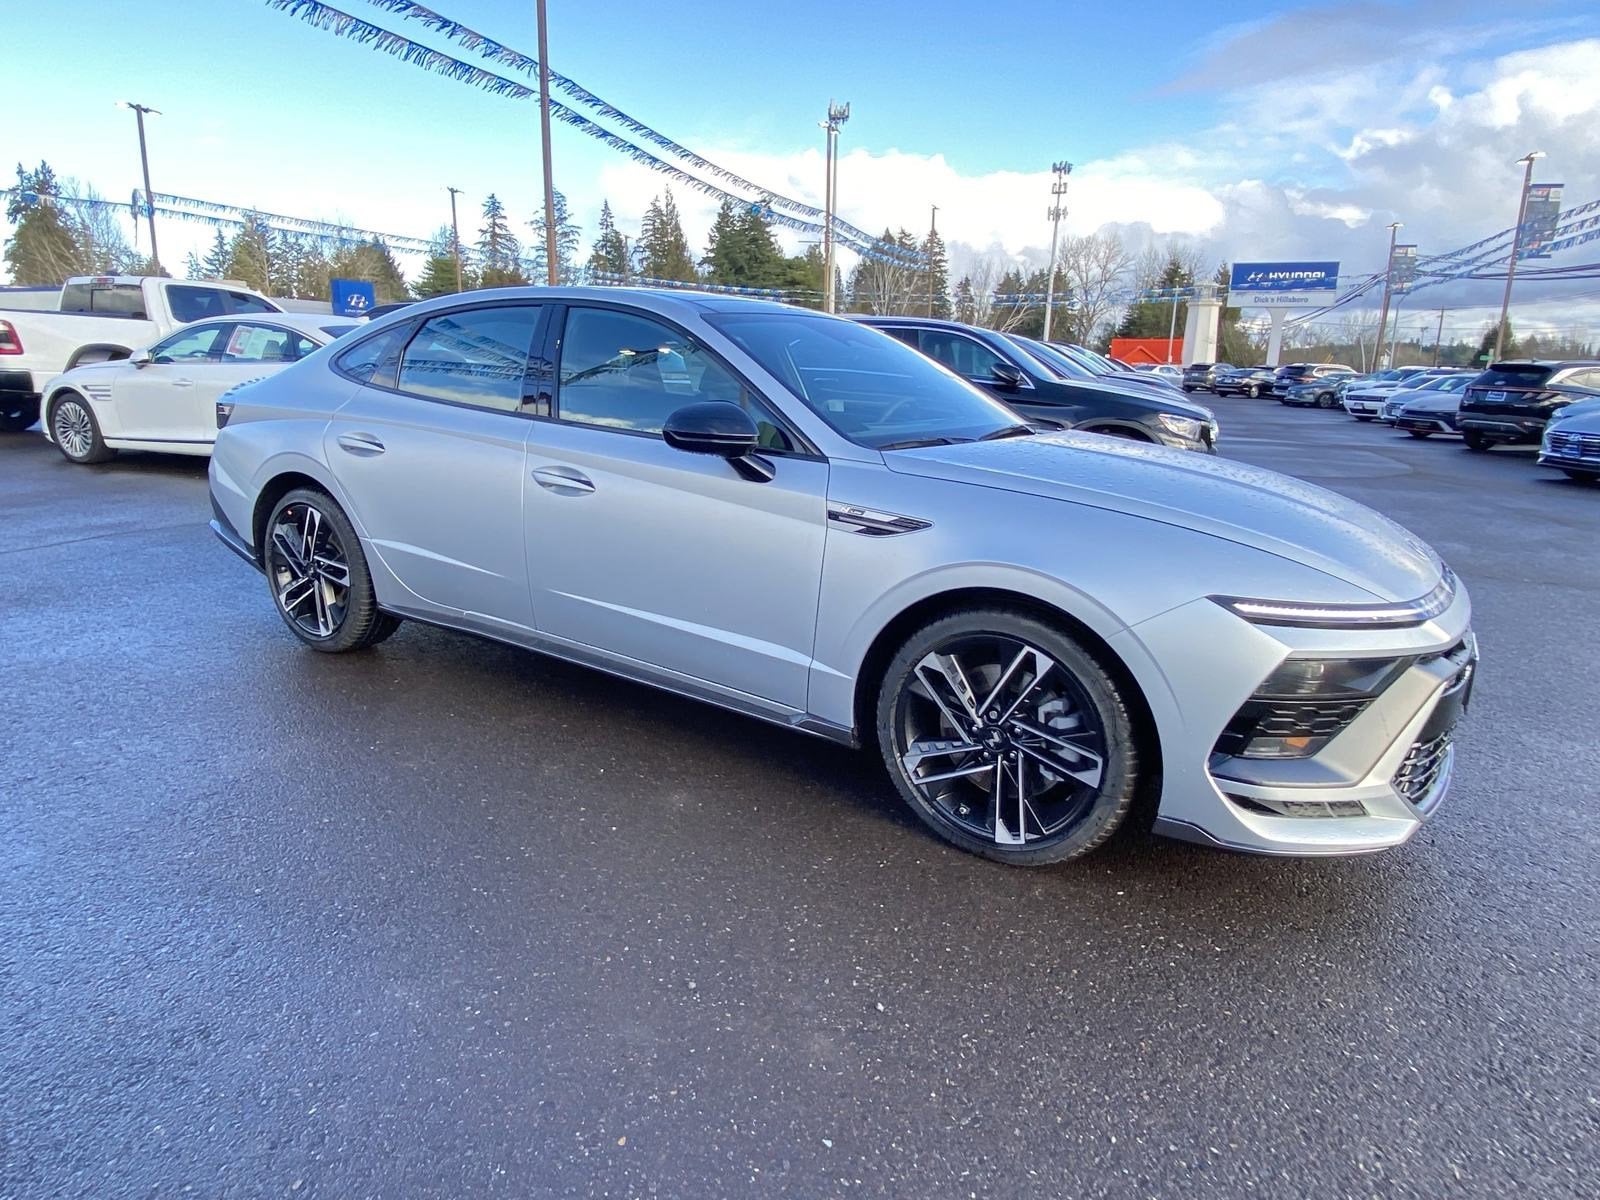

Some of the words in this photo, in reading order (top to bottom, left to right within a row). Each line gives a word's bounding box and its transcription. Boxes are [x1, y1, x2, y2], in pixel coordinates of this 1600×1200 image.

[1269, 271, 1325, 279] HYUNDAI
[1254, 296, 1275, 304] Dick's
[1276, 296, 1309, 304] Hillsboro
